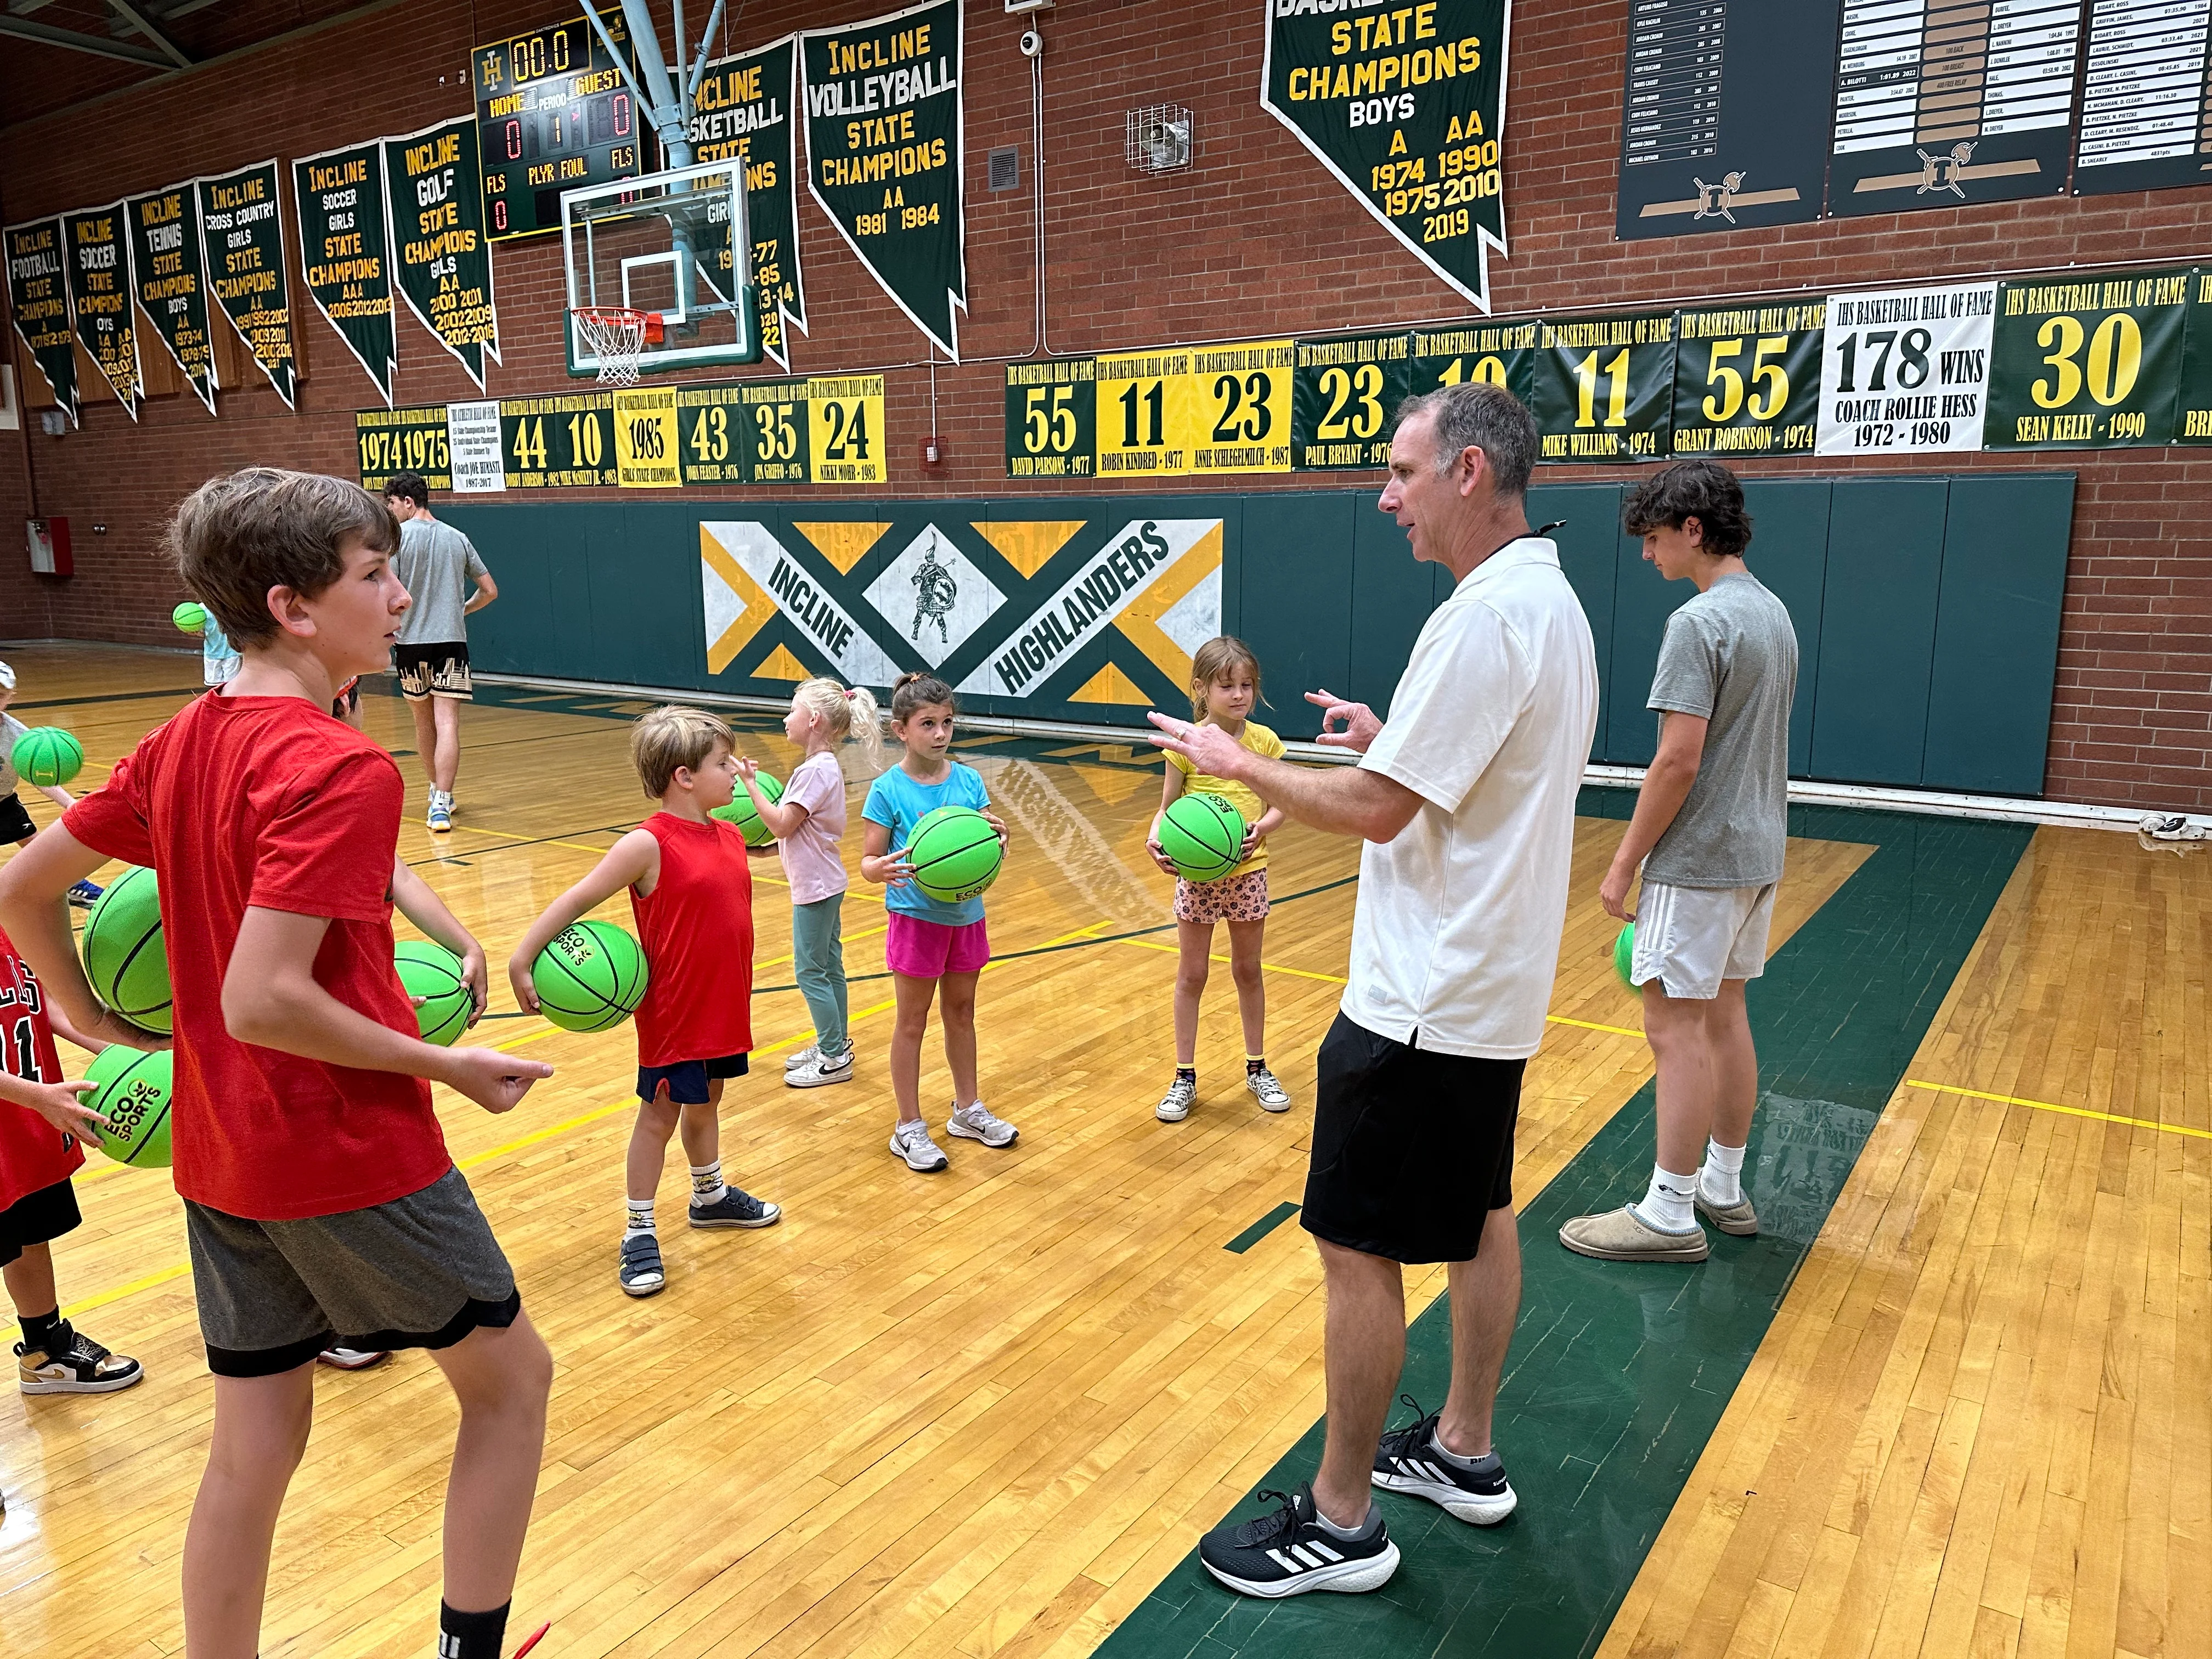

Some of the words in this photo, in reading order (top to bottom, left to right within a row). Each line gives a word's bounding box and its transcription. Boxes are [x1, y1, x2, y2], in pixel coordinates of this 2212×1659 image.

[1331, 2, 1437, 55] STATE
[514, 30, 569, 82] 00.0
[828, 24, 931, 76] INCLINE
[575, 68, 620, 96] GUEST
[1289, 36, 1480, 102] CHAMPIONS
[1847, 77, 1866, 85] BILOTTI
[539, 93, 567, 111] PERIOD
[809, 57, 957, 117] VOLLEYBALL
[489, 92, 526, 118] HOME
[613, 94, 630, 136] 0
[690, 98, 783, 143] SKETBALL
[1350, 93, 1415, 128] BOYS
[505, 120, 521, 159] 0
[555, 117, 561, 142] 1
[847, 110, 915, 149] STATE
[1389, 129, 1408, 156] A
[1445, 110, 1483, 144] AA
[405, 134, 460, 176] INCLINE
[611, 147, 633, 169] FLS
[698, 137, 751, 163] STATE
[822, 138, 947, 186] CHAMPIONS
[1372, 158, 1425, 191] 1974
[1438, 139, 1498, 178] 1990
[308, 160, 367, 192] INCLINE
[487, 173, 506, 194] FLS
[528, 163, 555, 185] PLYR
[560, 157, 588, 179] FOUL
[211, 178, 265, 210] INCLINE
[323, 188, 357, 210] SOCCER
[417, 168, 454, 207] GOLF
[883, 185, 904, 208] AA
[1385, 182, 1441, 217] 1975
[1443, 169, 1499, 207] 2010
[142, 194, 182, 226] INCLINE
[205, 215, 233, 230] CROSS
[236, 200, 274, 226] COUNTRY
[329, 212, 354, 231] GIRLS
[419, 202, 458, 235] STATE
[495, 200, 507, 230] 0
[856, 213, 886, 235] 1981
[901, 203, 940, 229] 1984
[1423, 208, 1469, 243] 2019
[14, 229, 53, 255] INCLINE
[146, 223, 182, 252] TENNIS
[227, 229, 251, 249] GIRLS
[325, 233, 362, 258] STATE
[405, 230, 476, 264] CHAMPIONS
[12, 251, 60, 279] FOOTBALL
[79, 244, 116, 269] SOCCER
[153, 251, 182, 275] STATE
[226, 247, 262, 273] STATE
[144, 273, 195, 301] CHAMPIONS
[216, 270, 276, 299] CHAMPIONS
[309, 258, 380, 287] CHAMPIONS
[439, 274, 460, 292] AA
[26, 278, 52, 299] STATE
[342, 283, 364, 300] AAA
[2005, 288, 2025, 316] IHS
[2027, 283, 2099, 315] BASKETBALL
[2102, 280, 2132, 310] HALL
[2136, 279, 2153, 307] OF
[2154, 276, 2186, 306] FAME
[168, 297, 187, 314] BOYS
[1837, 302, 1854, 327] IHS
[1857, 297, 1918, 325] BASKETBALL
[1921, 294, 1947, 320] HALL
[1950, 293, 1964, 318] OF
[1966, 290, 1993, 316] FAME
[177, 315, 189, 329] AA
[1680, 314, 1697, 339] IHS
[1697, 310, 1757, 338] BASKETBALL
[1759, 308, 1783, 334] HALL
[1786, 306, 1799, 332] OF
[1801, 304, 1826, 330] FAME
[1837, 328, 1932, 393] 178
[1940, 348, 1984, 385] WINS
[2031, 312, 2142, 409] 30
[1573, 348, 1629, 427] 11
[1702, 335, 1789, 421] 55
[1119, 380, 1164, 447] 11
[1212, 372, 1272, 442] 23
[1318, 364, 1384, 440] 23
[1836, 399, 1882, 423] COACH
[1884, 396, 1937, 420] ROLLIE
[1940, 393, 1977, 418] HESS
[691, 407, 729, 461] 43
[755, 403, 797, 460] 35
[824, 400, 869, 460] 24
[1024, 385, 1076, 453] 55
[1854, 424, 1894, 447] 1972
[1910, 421, 1950, 445] 1980
[2016, 416, 2050, 442] SEAN
[2052, 414, 2095, 441] KELLY
[2108, 412, 2146, 439] 1990
[359, 431, 402, 470] 1974
[404, 428, 449, 469] 1975
[514, 416, 547, 469] 44
[568, 413, 602, 466] 10
[629, 416, 664, 459] 1985
[1542, 435, 1567, 457] MIKE
[1571, 433, 1618, 456] WILLIAMS
[1628, 432, 1655, 454] 1974
[1674, 428, 1712, 452] GRANT
[1714, 426, 1773, 450] ROBINSON
[1783, 425, 1813, 448] 1974
[455, 462, 468, 475] Coach
[1012, 458, 1033, 476] DAVID
[1035, 456, 1065, 475] PARSONS
[1071, 455, 1090, 475] 1977
[1102, 453, 1124, 471] ROBIN
[1126, 452, 1157, 470] KINDRED
[1164, 450, 1183, 469] 1977
[1194, 449, 1212, 468] ANNIE
[1214, 447, 1265, 467] SCHLEGELMILCH
[1272, 447, 1289, 465] 1987
[1306, 445, 1326, 465] PAUL
[1328, 443, 1362, 465] BRYANT
[1370, 442, 1391, 464] 1976
[820, 465, 837, 481] NIKKI
[838, 465, 856, 481] MOHR
[861, 464, 876, 481] 1983
[769, 556, 855, 661] INCLINE
[994, 521, 1170, 696] HIGHLANDERS
[1208, 797, 1229, 813] ECO
[956, 886, 982, 899] ECO
[553, 935, 584, 966] SPORTS
[561, 928, 584, 947] ECO
[104, 1098, 134, 1136] ECO
[119, 1087, 161, 1142] SPORTS
[1633, 1225, 1645, 1235] UGG
